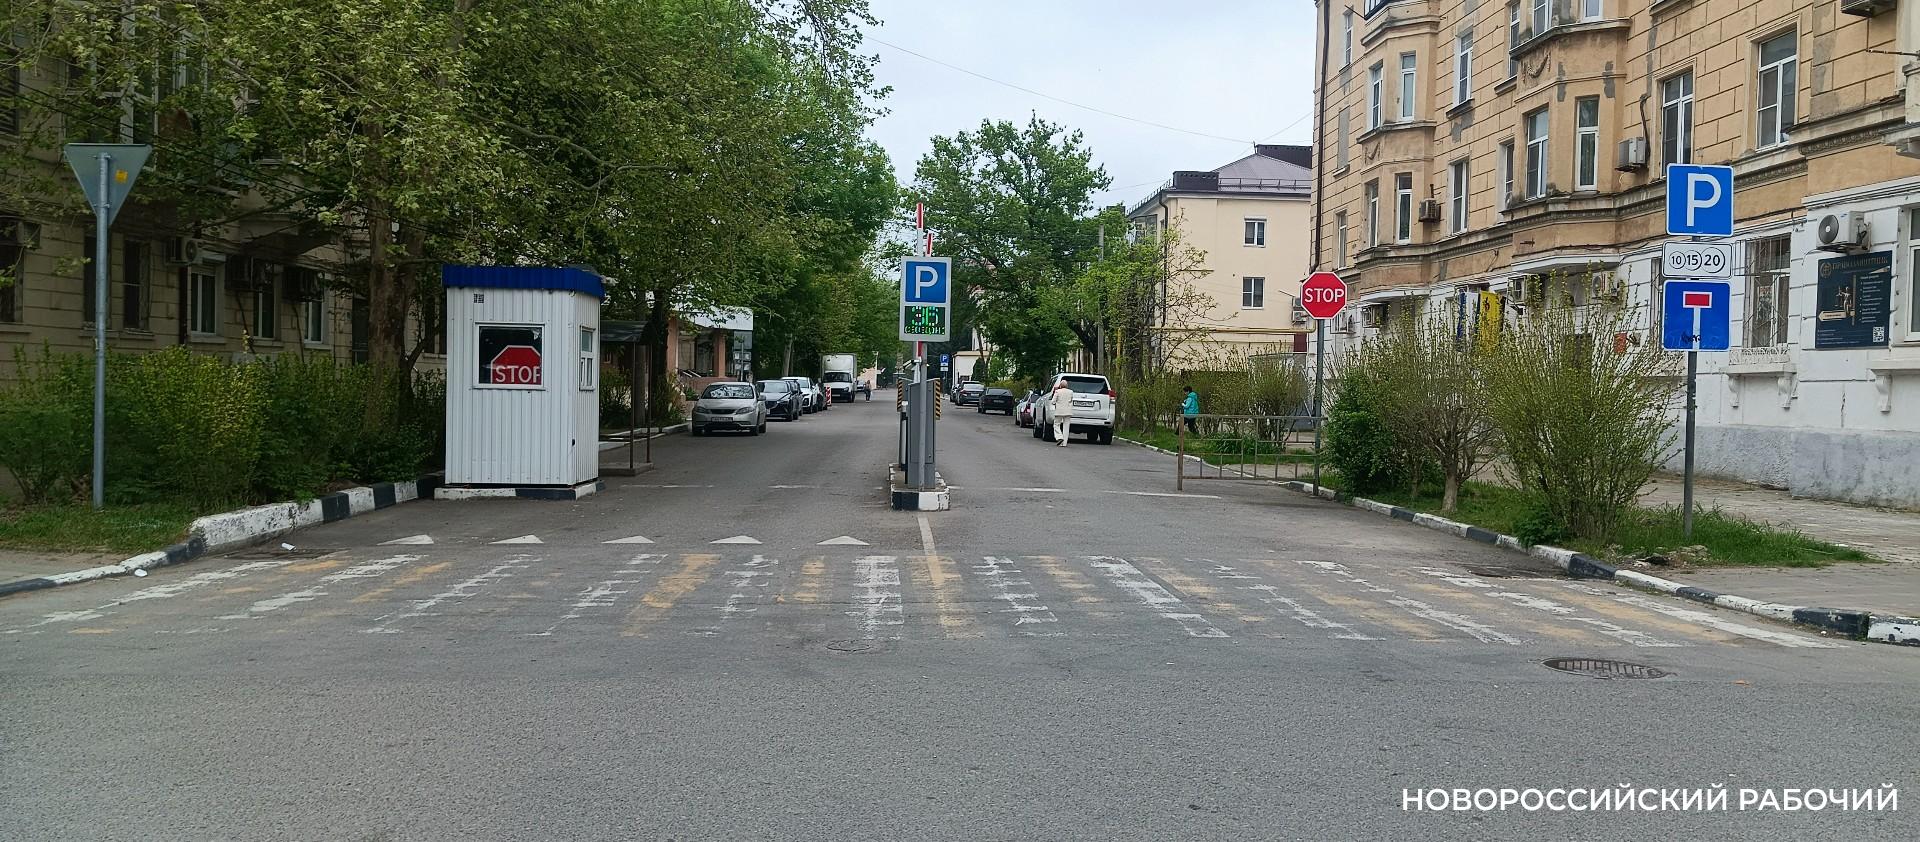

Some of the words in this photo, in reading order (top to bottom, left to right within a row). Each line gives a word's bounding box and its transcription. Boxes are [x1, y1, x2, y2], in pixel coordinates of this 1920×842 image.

[1686, 172, 1722, 227] P
[1671, 255, 1682, 265] 10
[1687, 254, 1699, 266] 15
[1703, 254, 1721, 266] 20
[915, 265, 939, 299] P
[1304, 287, 1345, 303] STOP
